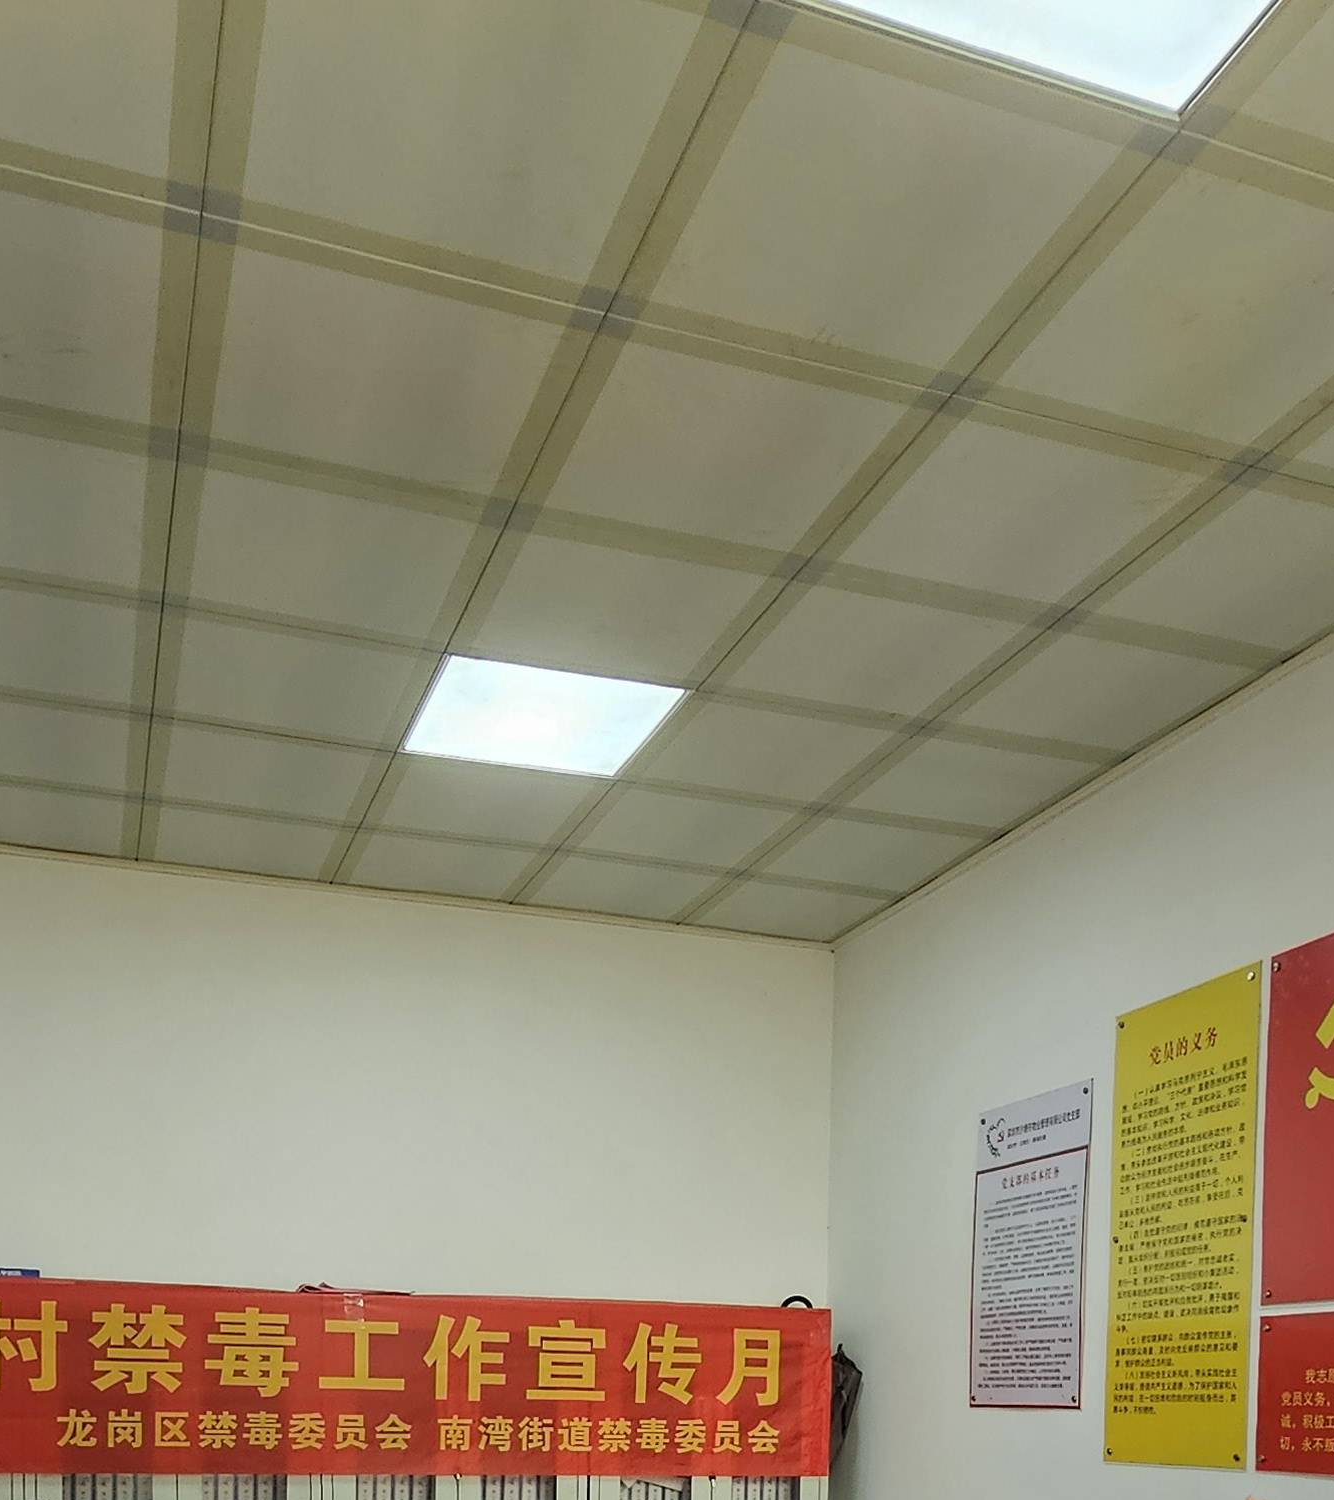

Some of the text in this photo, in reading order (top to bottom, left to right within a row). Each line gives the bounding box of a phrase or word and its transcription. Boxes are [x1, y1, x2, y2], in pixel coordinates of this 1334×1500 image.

[1148, 1027, 1218, 1067] 党员的义务
[56, 1408, 781, 1456] 龙岗区禁毒委员会 南湾街道禁毒委员会
